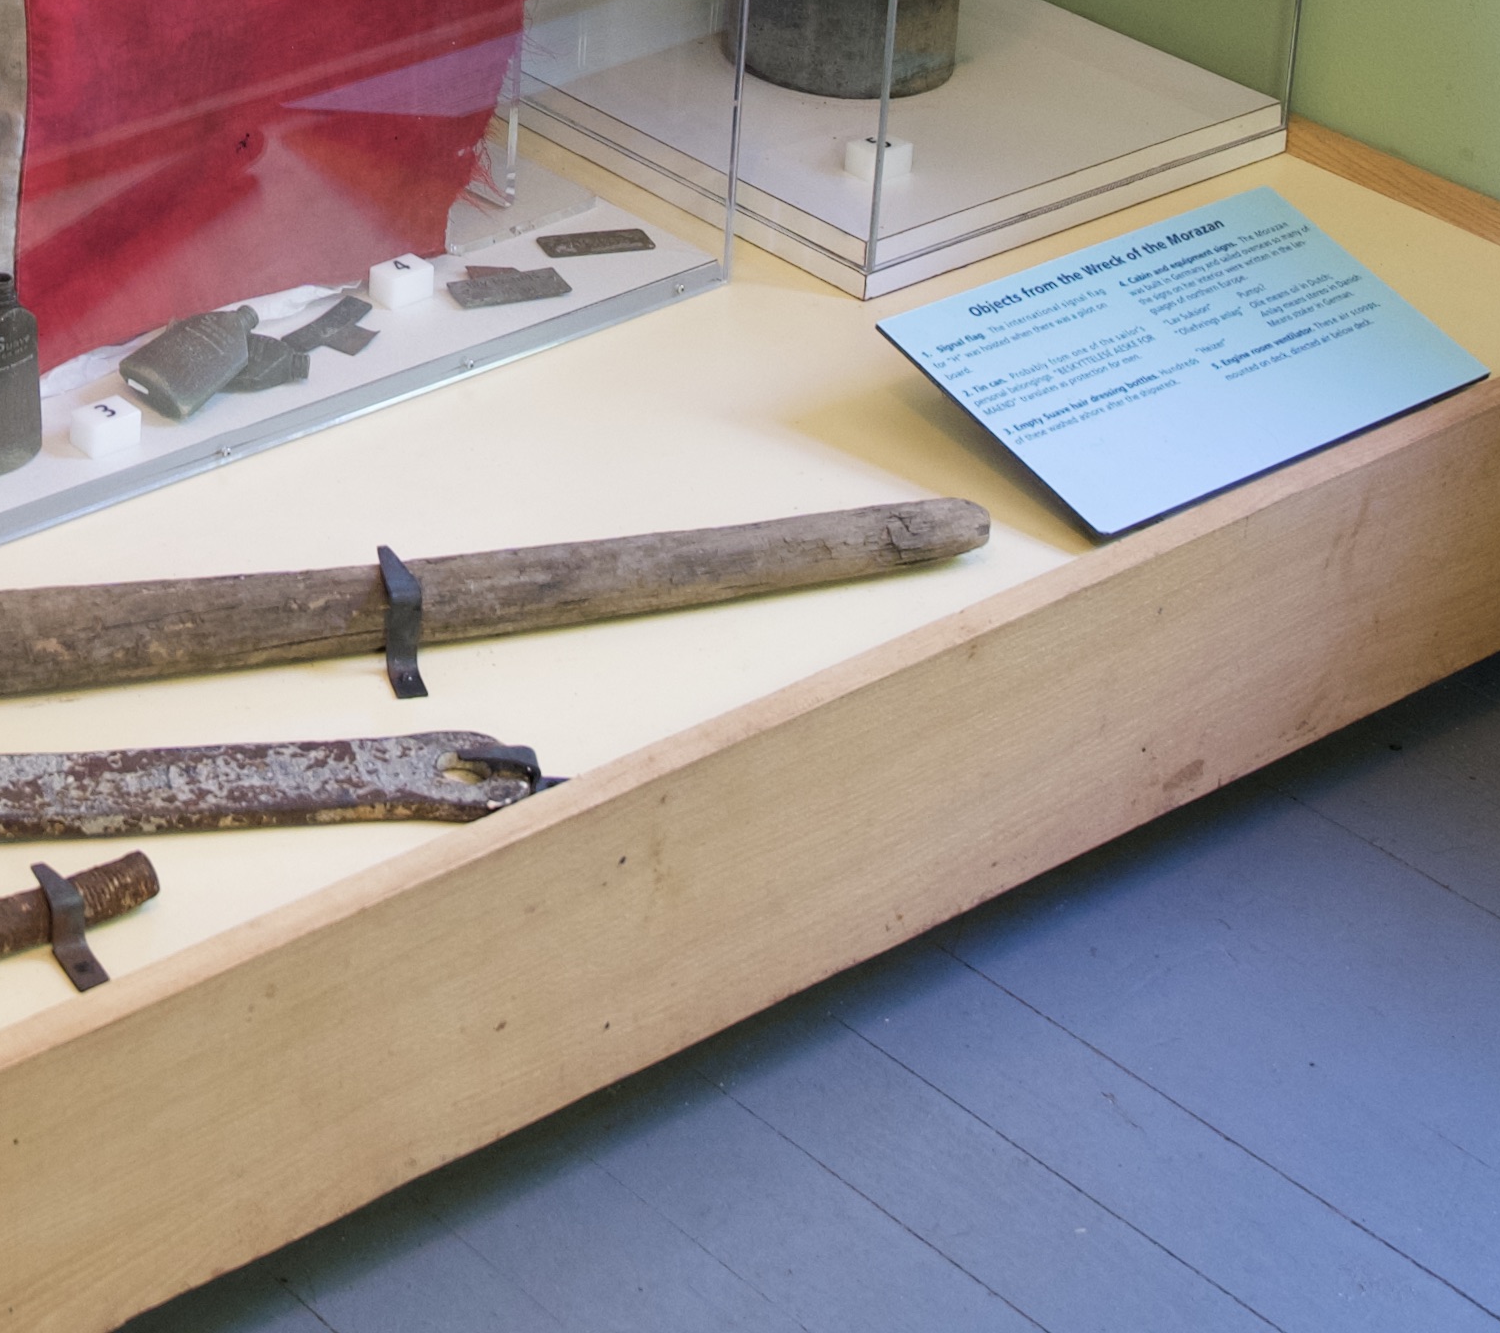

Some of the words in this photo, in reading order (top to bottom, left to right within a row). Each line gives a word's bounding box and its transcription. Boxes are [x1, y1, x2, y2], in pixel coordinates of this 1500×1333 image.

[393, 260, 410, 270] 4
[968, 293, 1023, 317] Objects
[1020, 280, 1059, 298] from
[1056, 271, 1084, 285] the
[1080, 254, 1127, 276] Wreck
[1126, 247, 1143, 261] of
[1141, 241, 1168, 255] the
[1165, 220, 1225, 246] Morazan
[94, 404, 116, 417] 3
